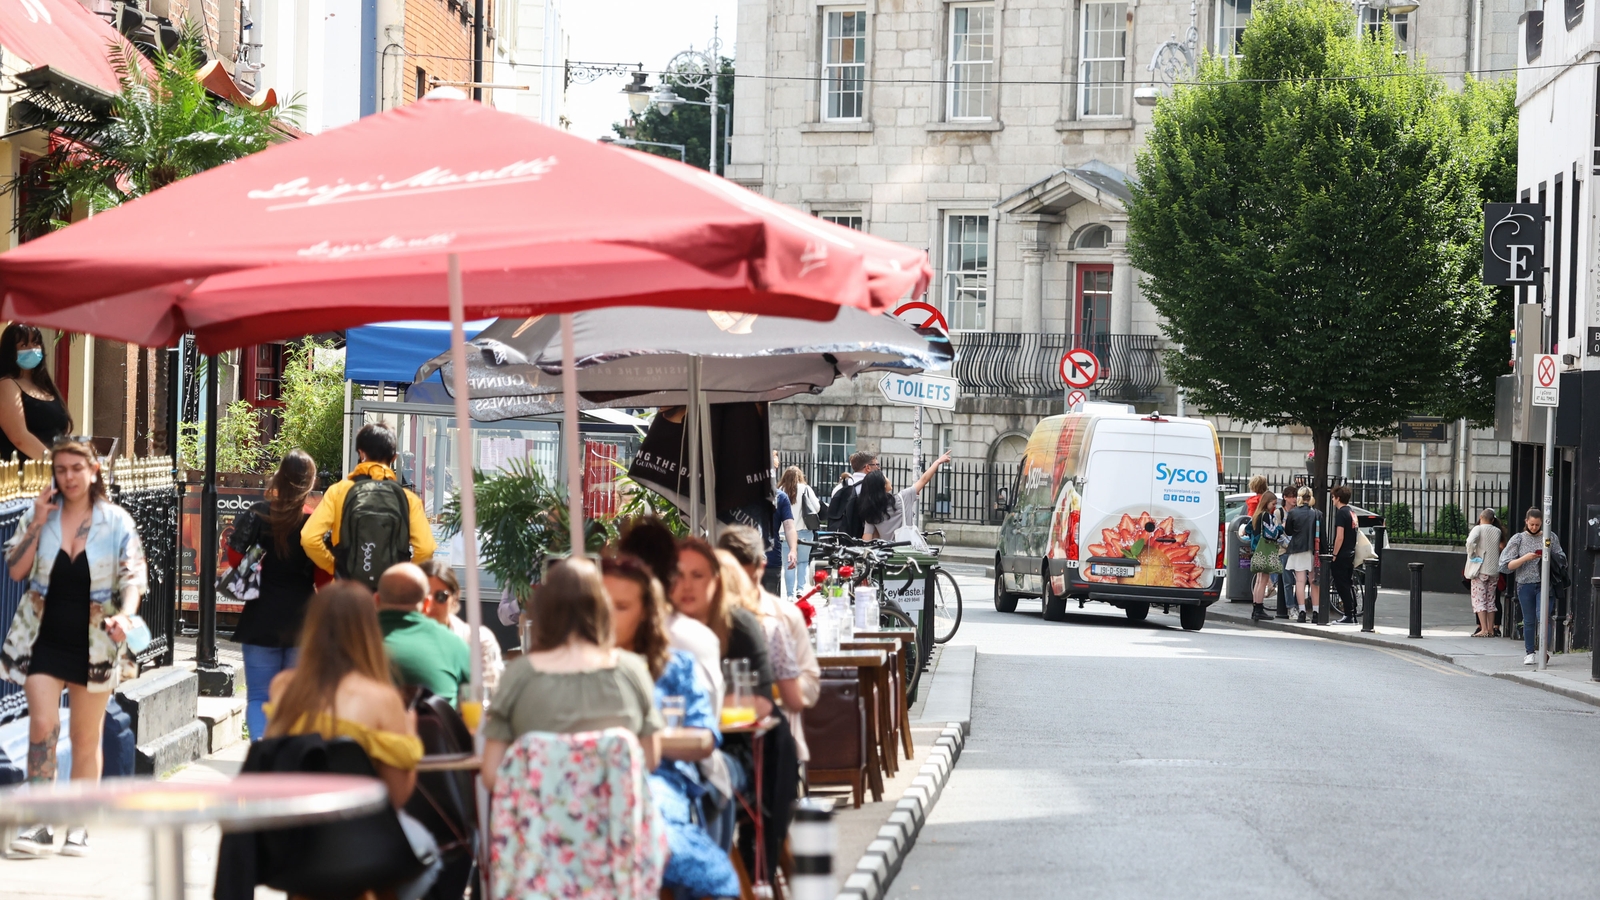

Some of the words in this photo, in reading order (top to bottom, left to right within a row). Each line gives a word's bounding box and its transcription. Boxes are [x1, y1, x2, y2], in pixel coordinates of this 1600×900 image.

[896, 379, 951, 402] TOILETS
[655, 456, 677, 473] THE
[1155, 462, 1208, 485] Sysco
